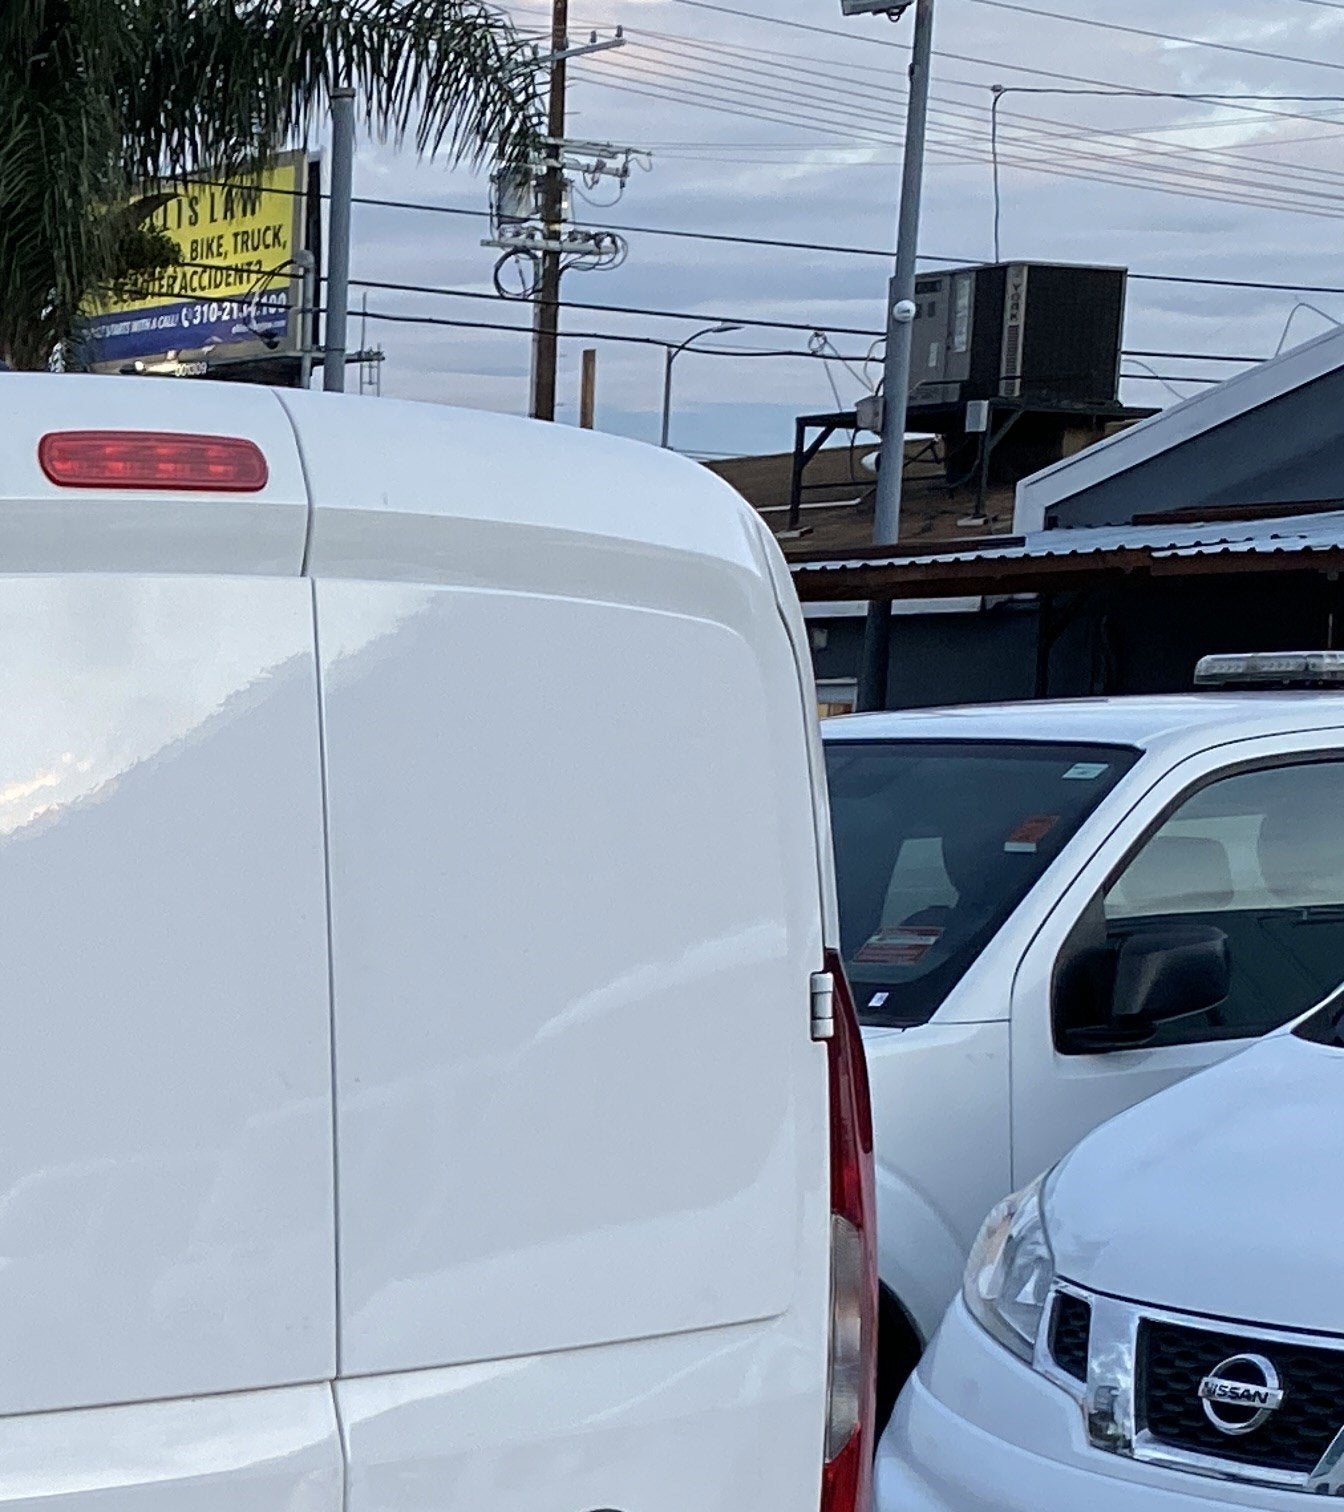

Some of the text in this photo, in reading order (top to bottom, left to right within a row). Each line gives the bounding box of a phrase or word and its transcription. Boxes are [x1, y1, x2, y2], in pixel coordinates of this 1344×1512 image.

[189, 232, 229, 264] BIKE,
[232, 222, 288, 257] TRUCK,
[1203, 1380, 1270, 1405] NISSAN
